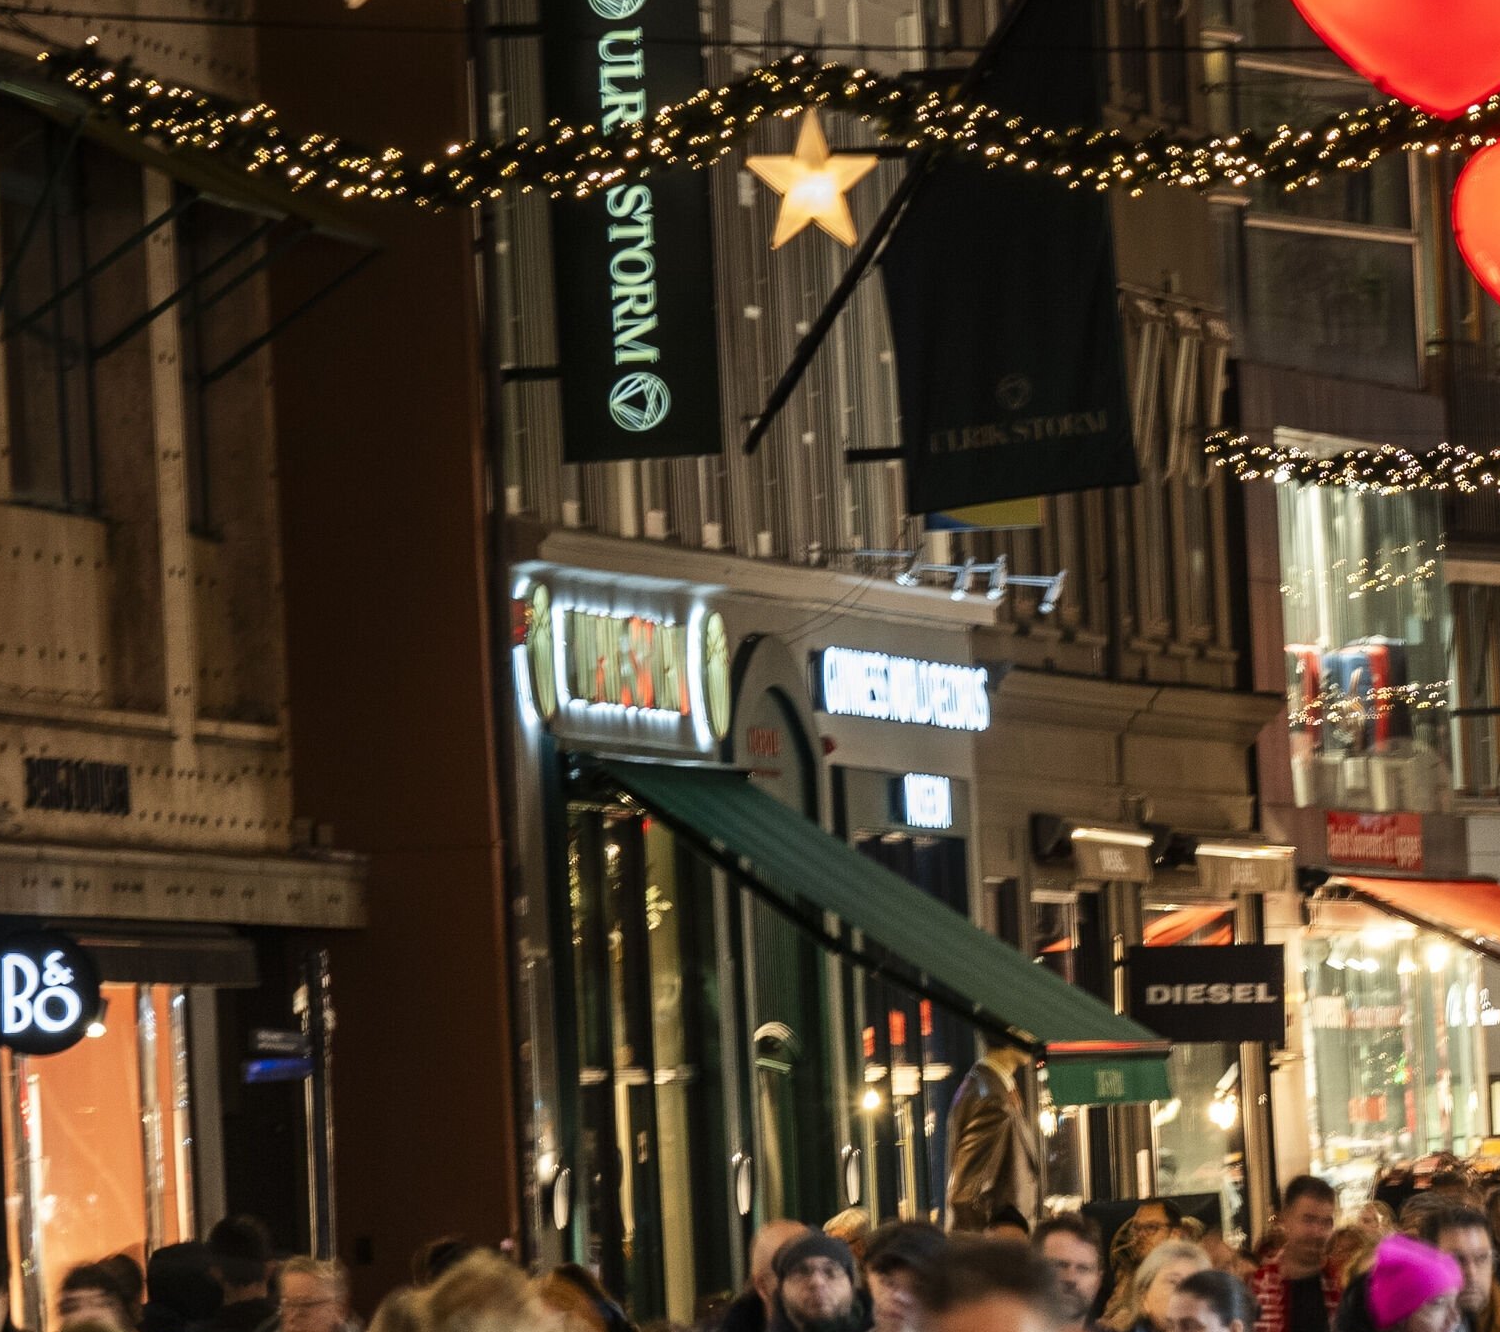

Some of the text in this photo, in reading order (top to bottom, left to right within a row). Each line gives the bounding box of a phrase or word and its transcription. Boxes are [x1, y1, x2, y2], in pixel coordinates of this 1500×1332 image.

[598, 27, 660, 365] ULR STORM
[1145, 982, 1278, 1006] DIESEL
